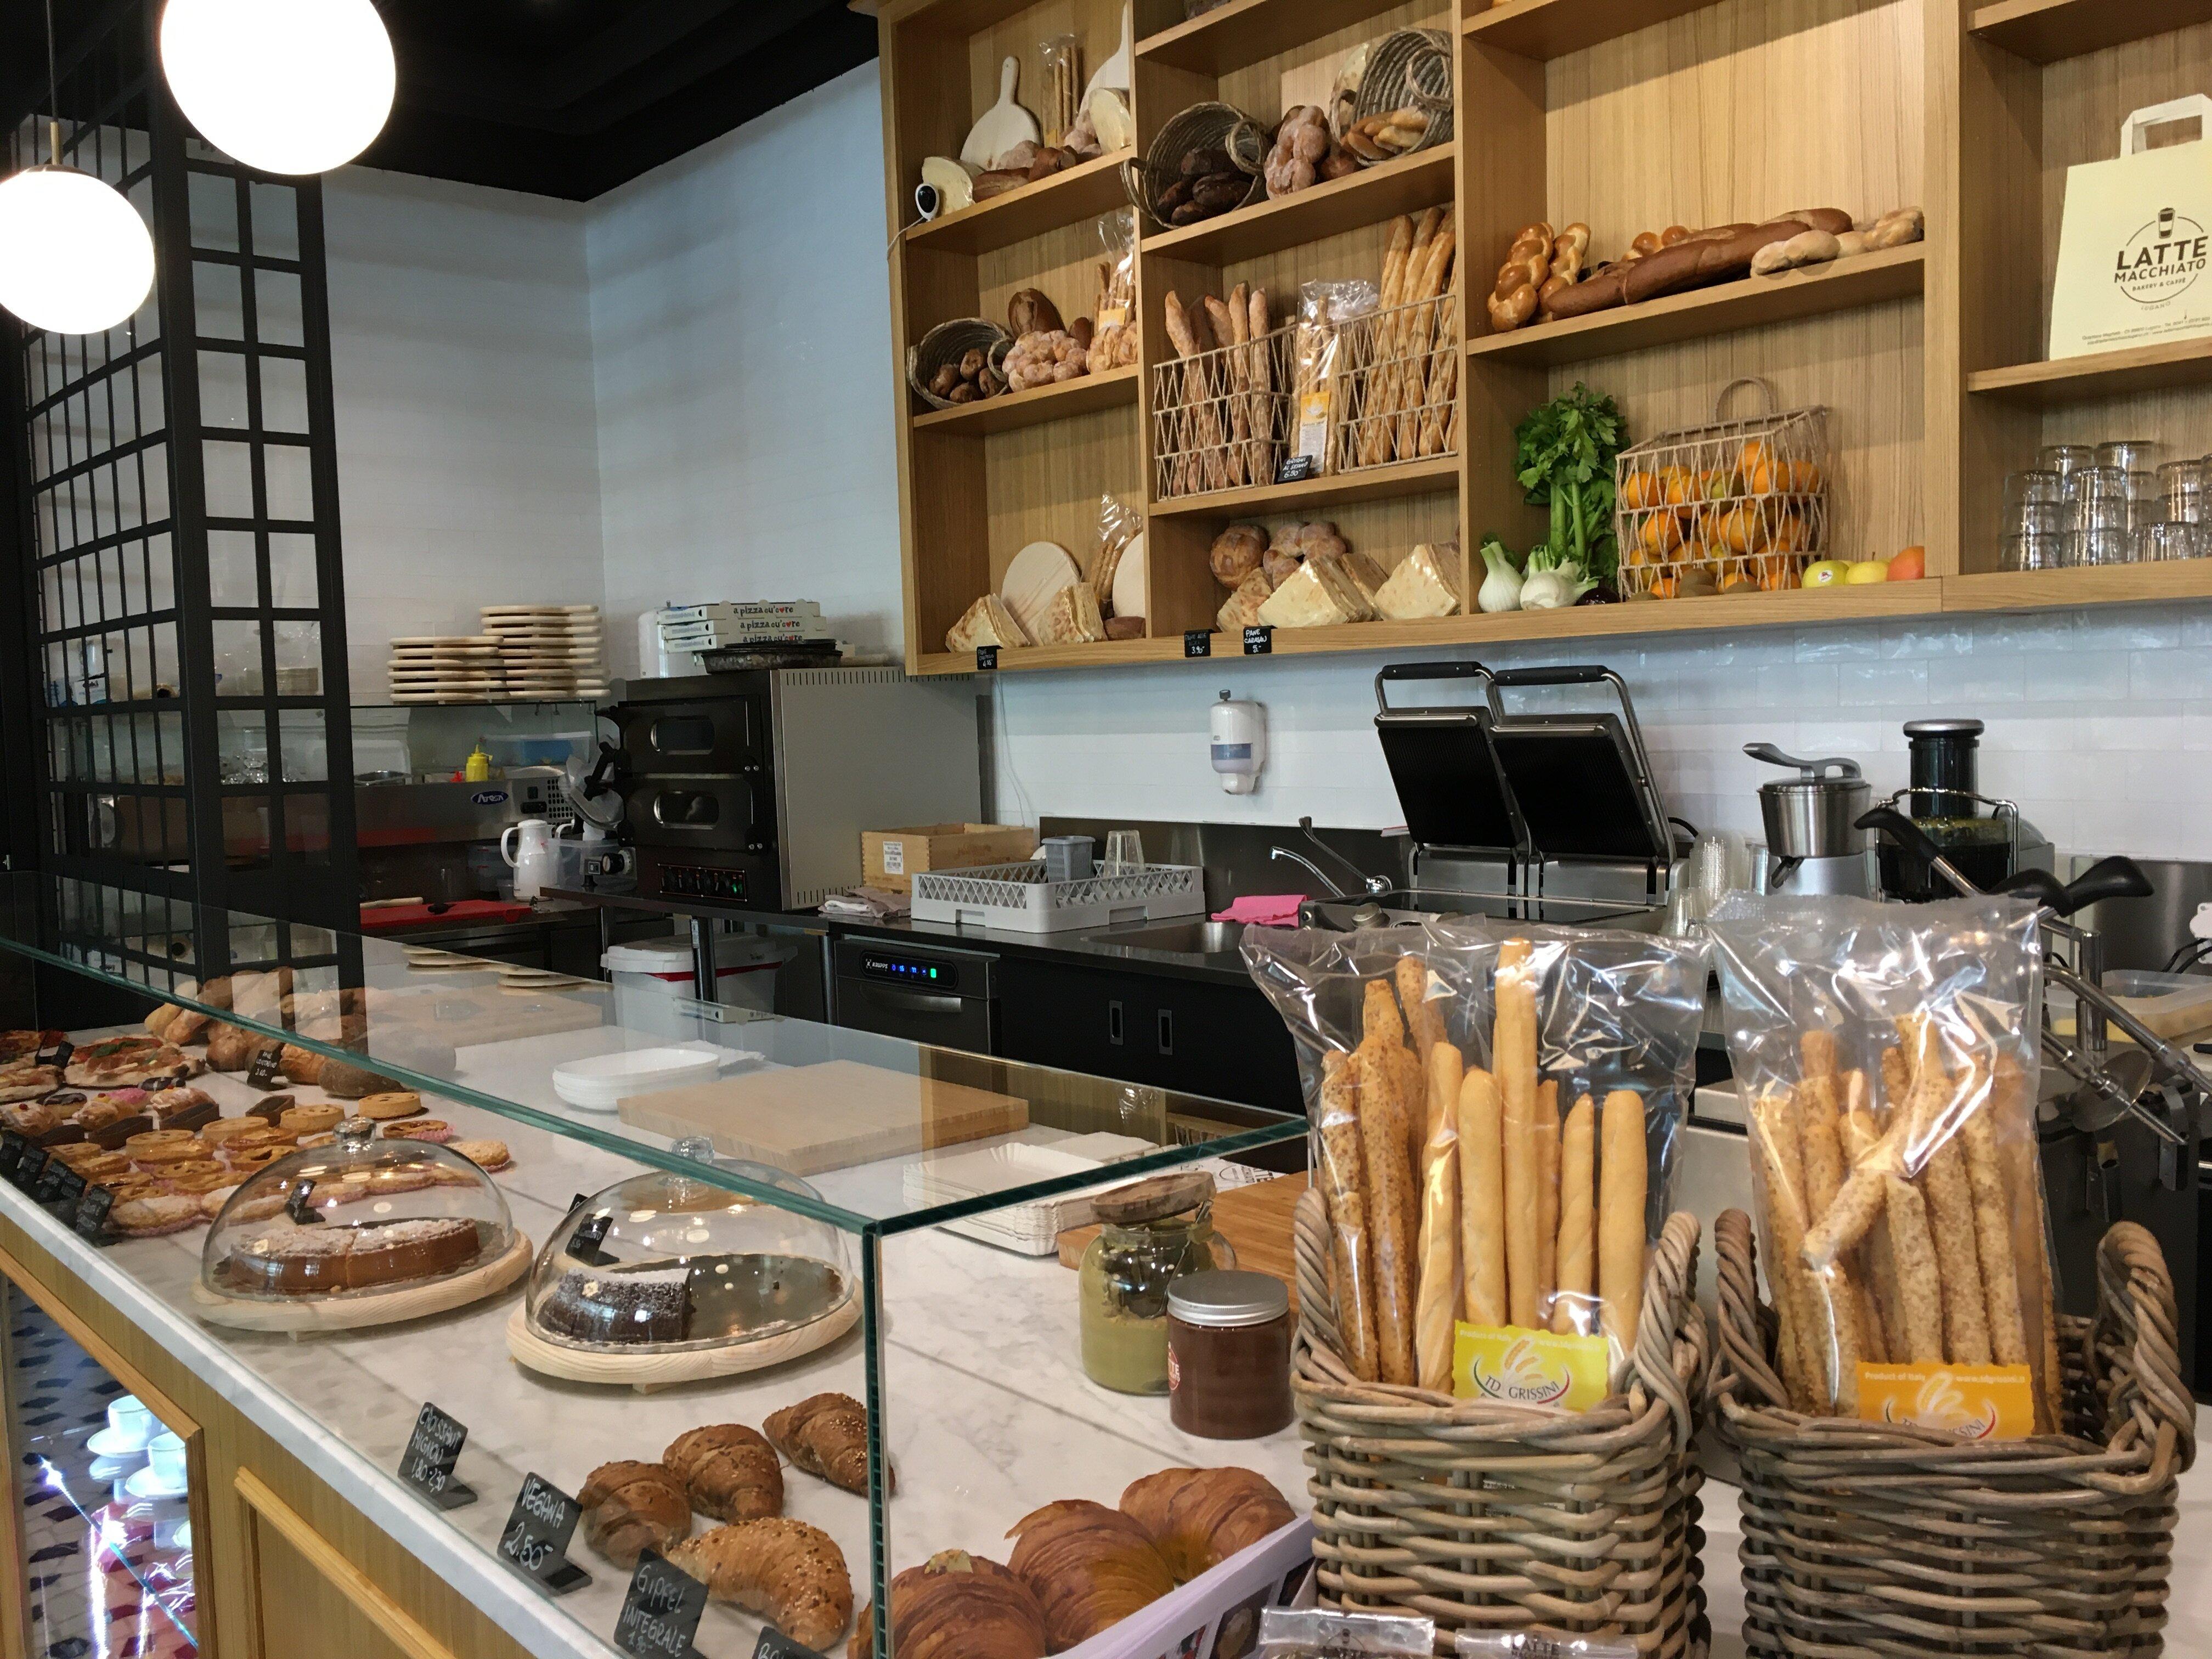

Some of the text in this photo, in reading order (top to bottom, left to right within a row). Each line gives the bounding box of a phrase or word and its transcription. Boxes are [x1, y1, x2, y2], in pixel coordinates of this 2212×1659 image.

[2117, 235, 2209, 270] LATTE
[2114, 258, 2206, 283] MACCHIATO
[740, 605, 764, 617] pizza
[747, 620, 770, 631] pizza
[1245, 629, 1260, 637] PANE
[1485, 1375, 1560, 1400] TD GRISSINI
[419, 1407, 462, 1450] CROISSANT
[521, 1478, 565, 1530] VEGANA
[637, 1564, 685, 1614] GIPFEL
[623, 1598, 686, 1657] INTEGRALE
